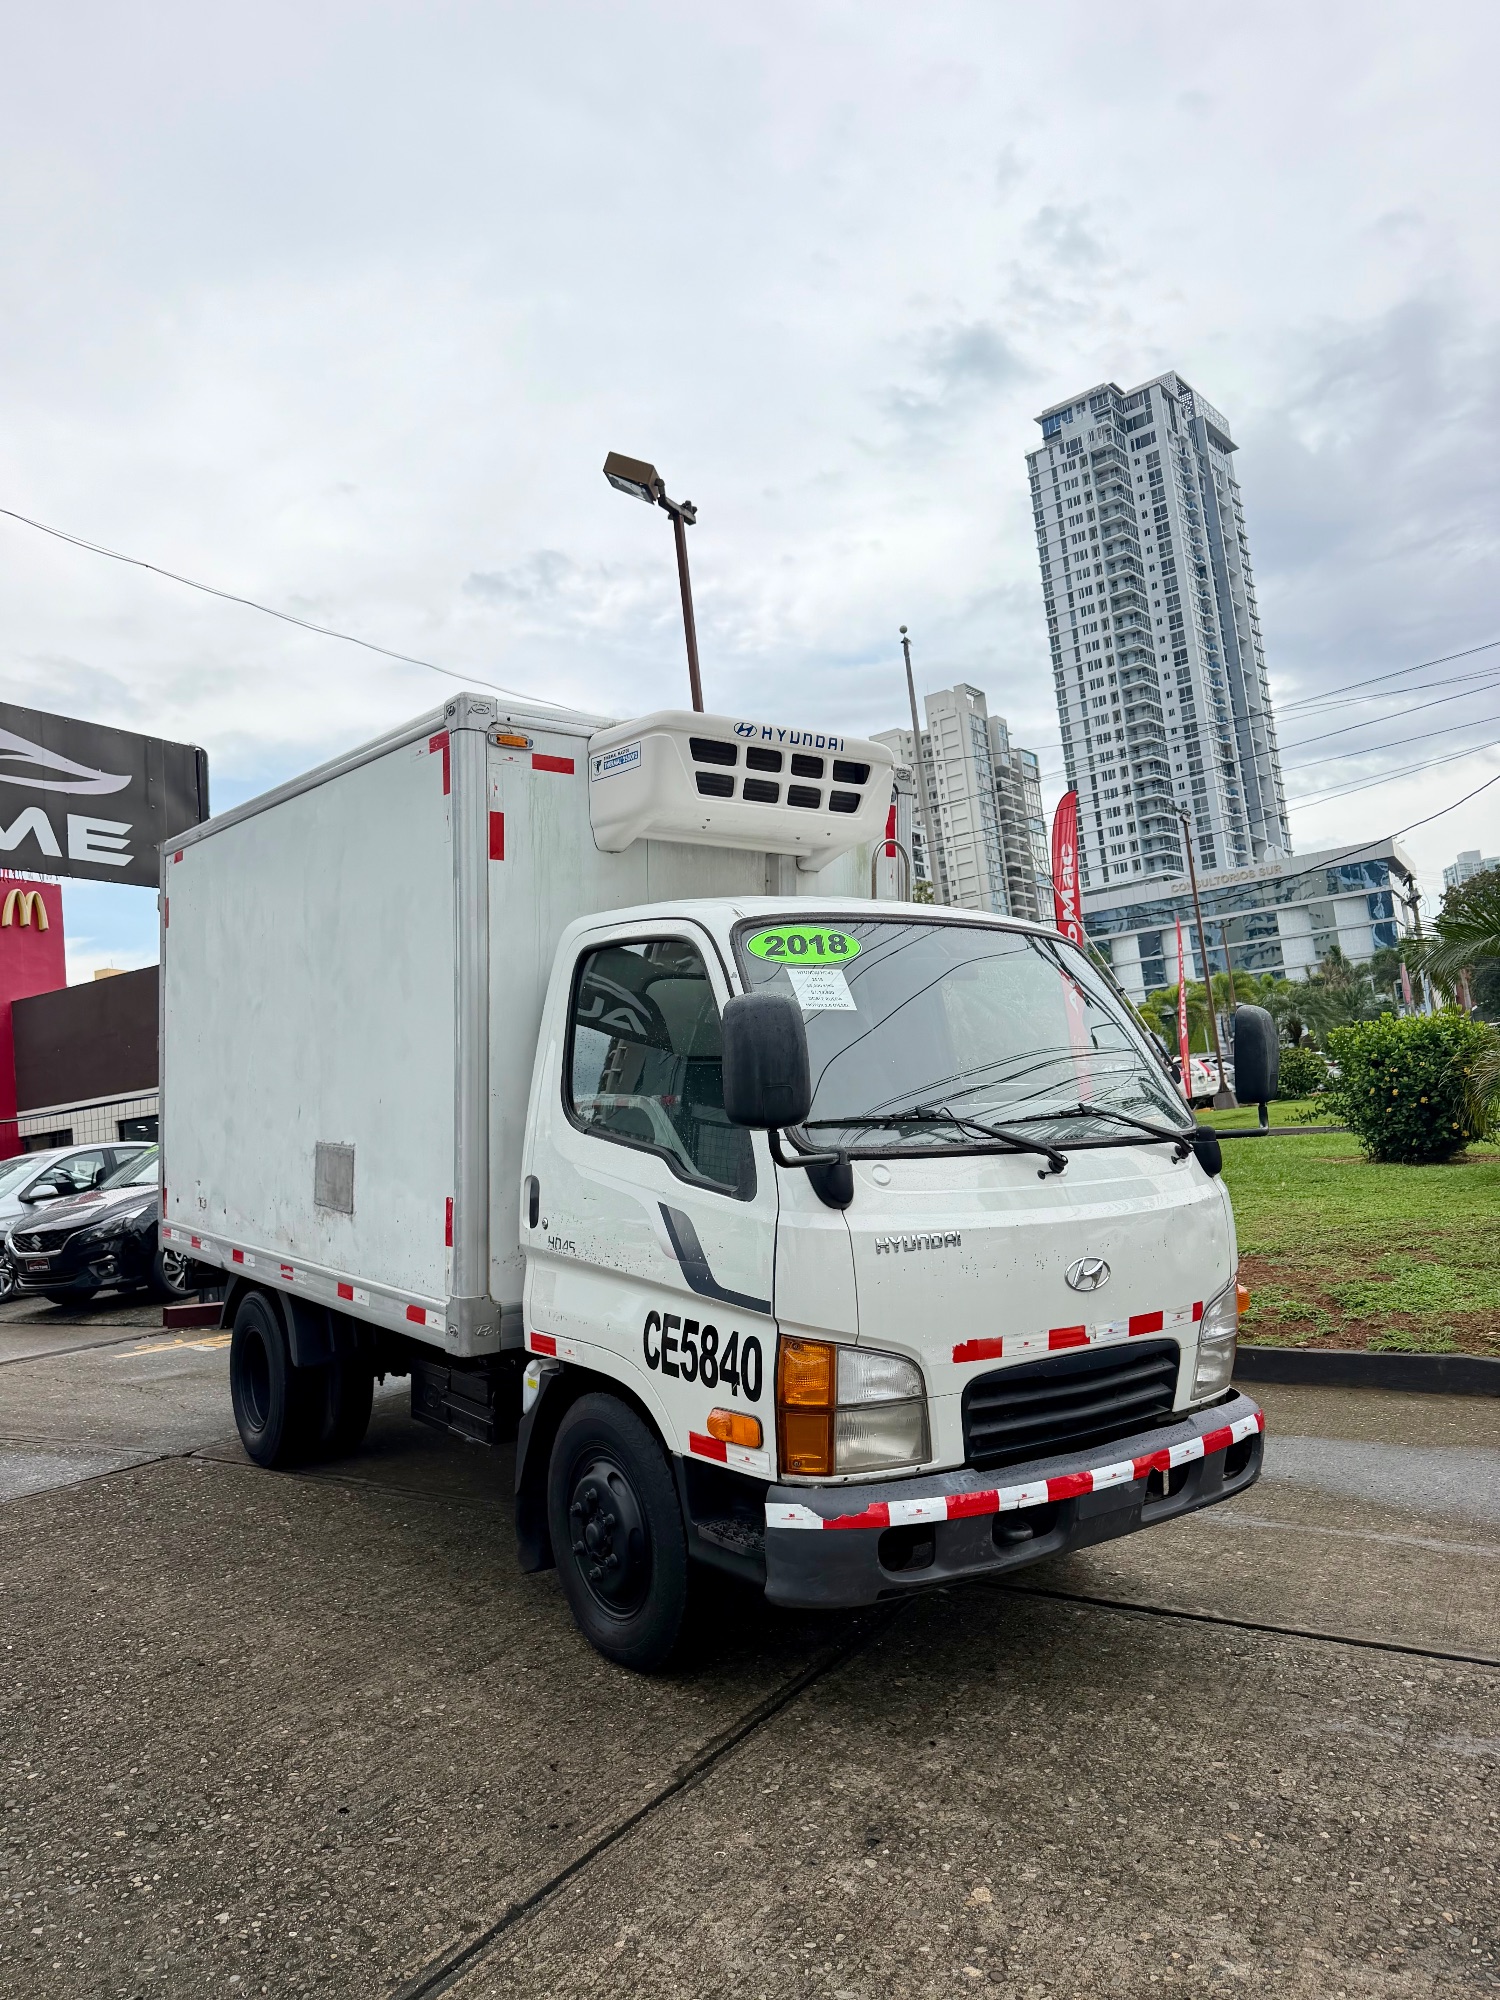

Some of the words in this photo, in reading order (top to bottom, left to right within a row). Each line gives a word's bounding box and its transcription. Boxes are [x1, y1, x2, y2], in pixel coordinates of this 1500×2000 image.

[761, 725, 845, 752] HYUNDAI
[1259, 864, 1283, 877] SUR
[763, 933, 850, 957] 2018
[874, 1230, 962, 1255] HYUNDAI
[643, 1310, 763, 1402] CE5840
